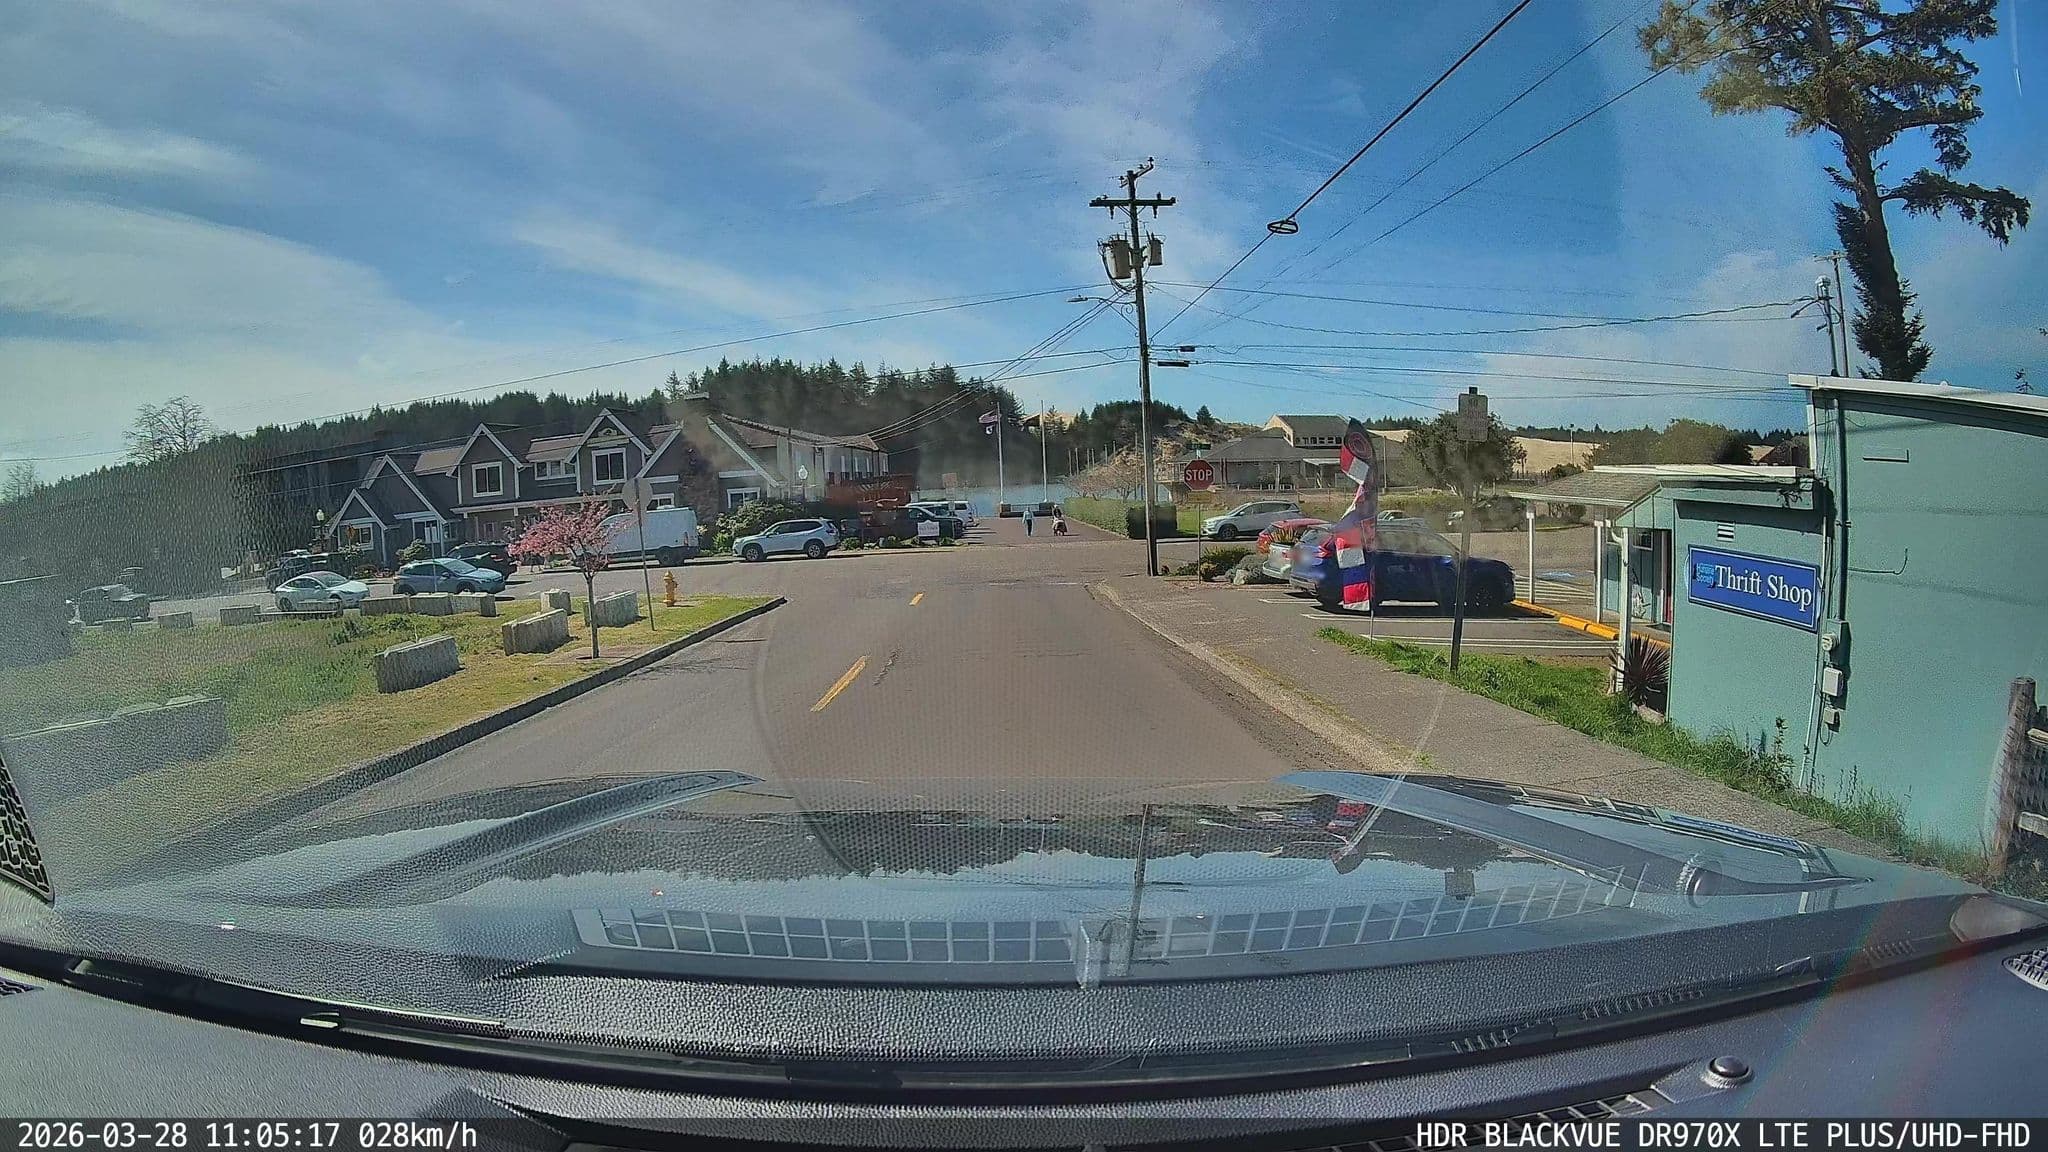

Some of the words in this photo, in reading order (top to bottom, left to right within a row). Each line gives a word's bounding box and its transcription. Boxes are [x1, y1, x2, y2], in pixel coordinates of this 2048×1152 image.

[1185, 469, 1212, 481] STOP
[1715, 565, 1763, 595] Thrift
[1767, 573, 1812, 612] Shop
